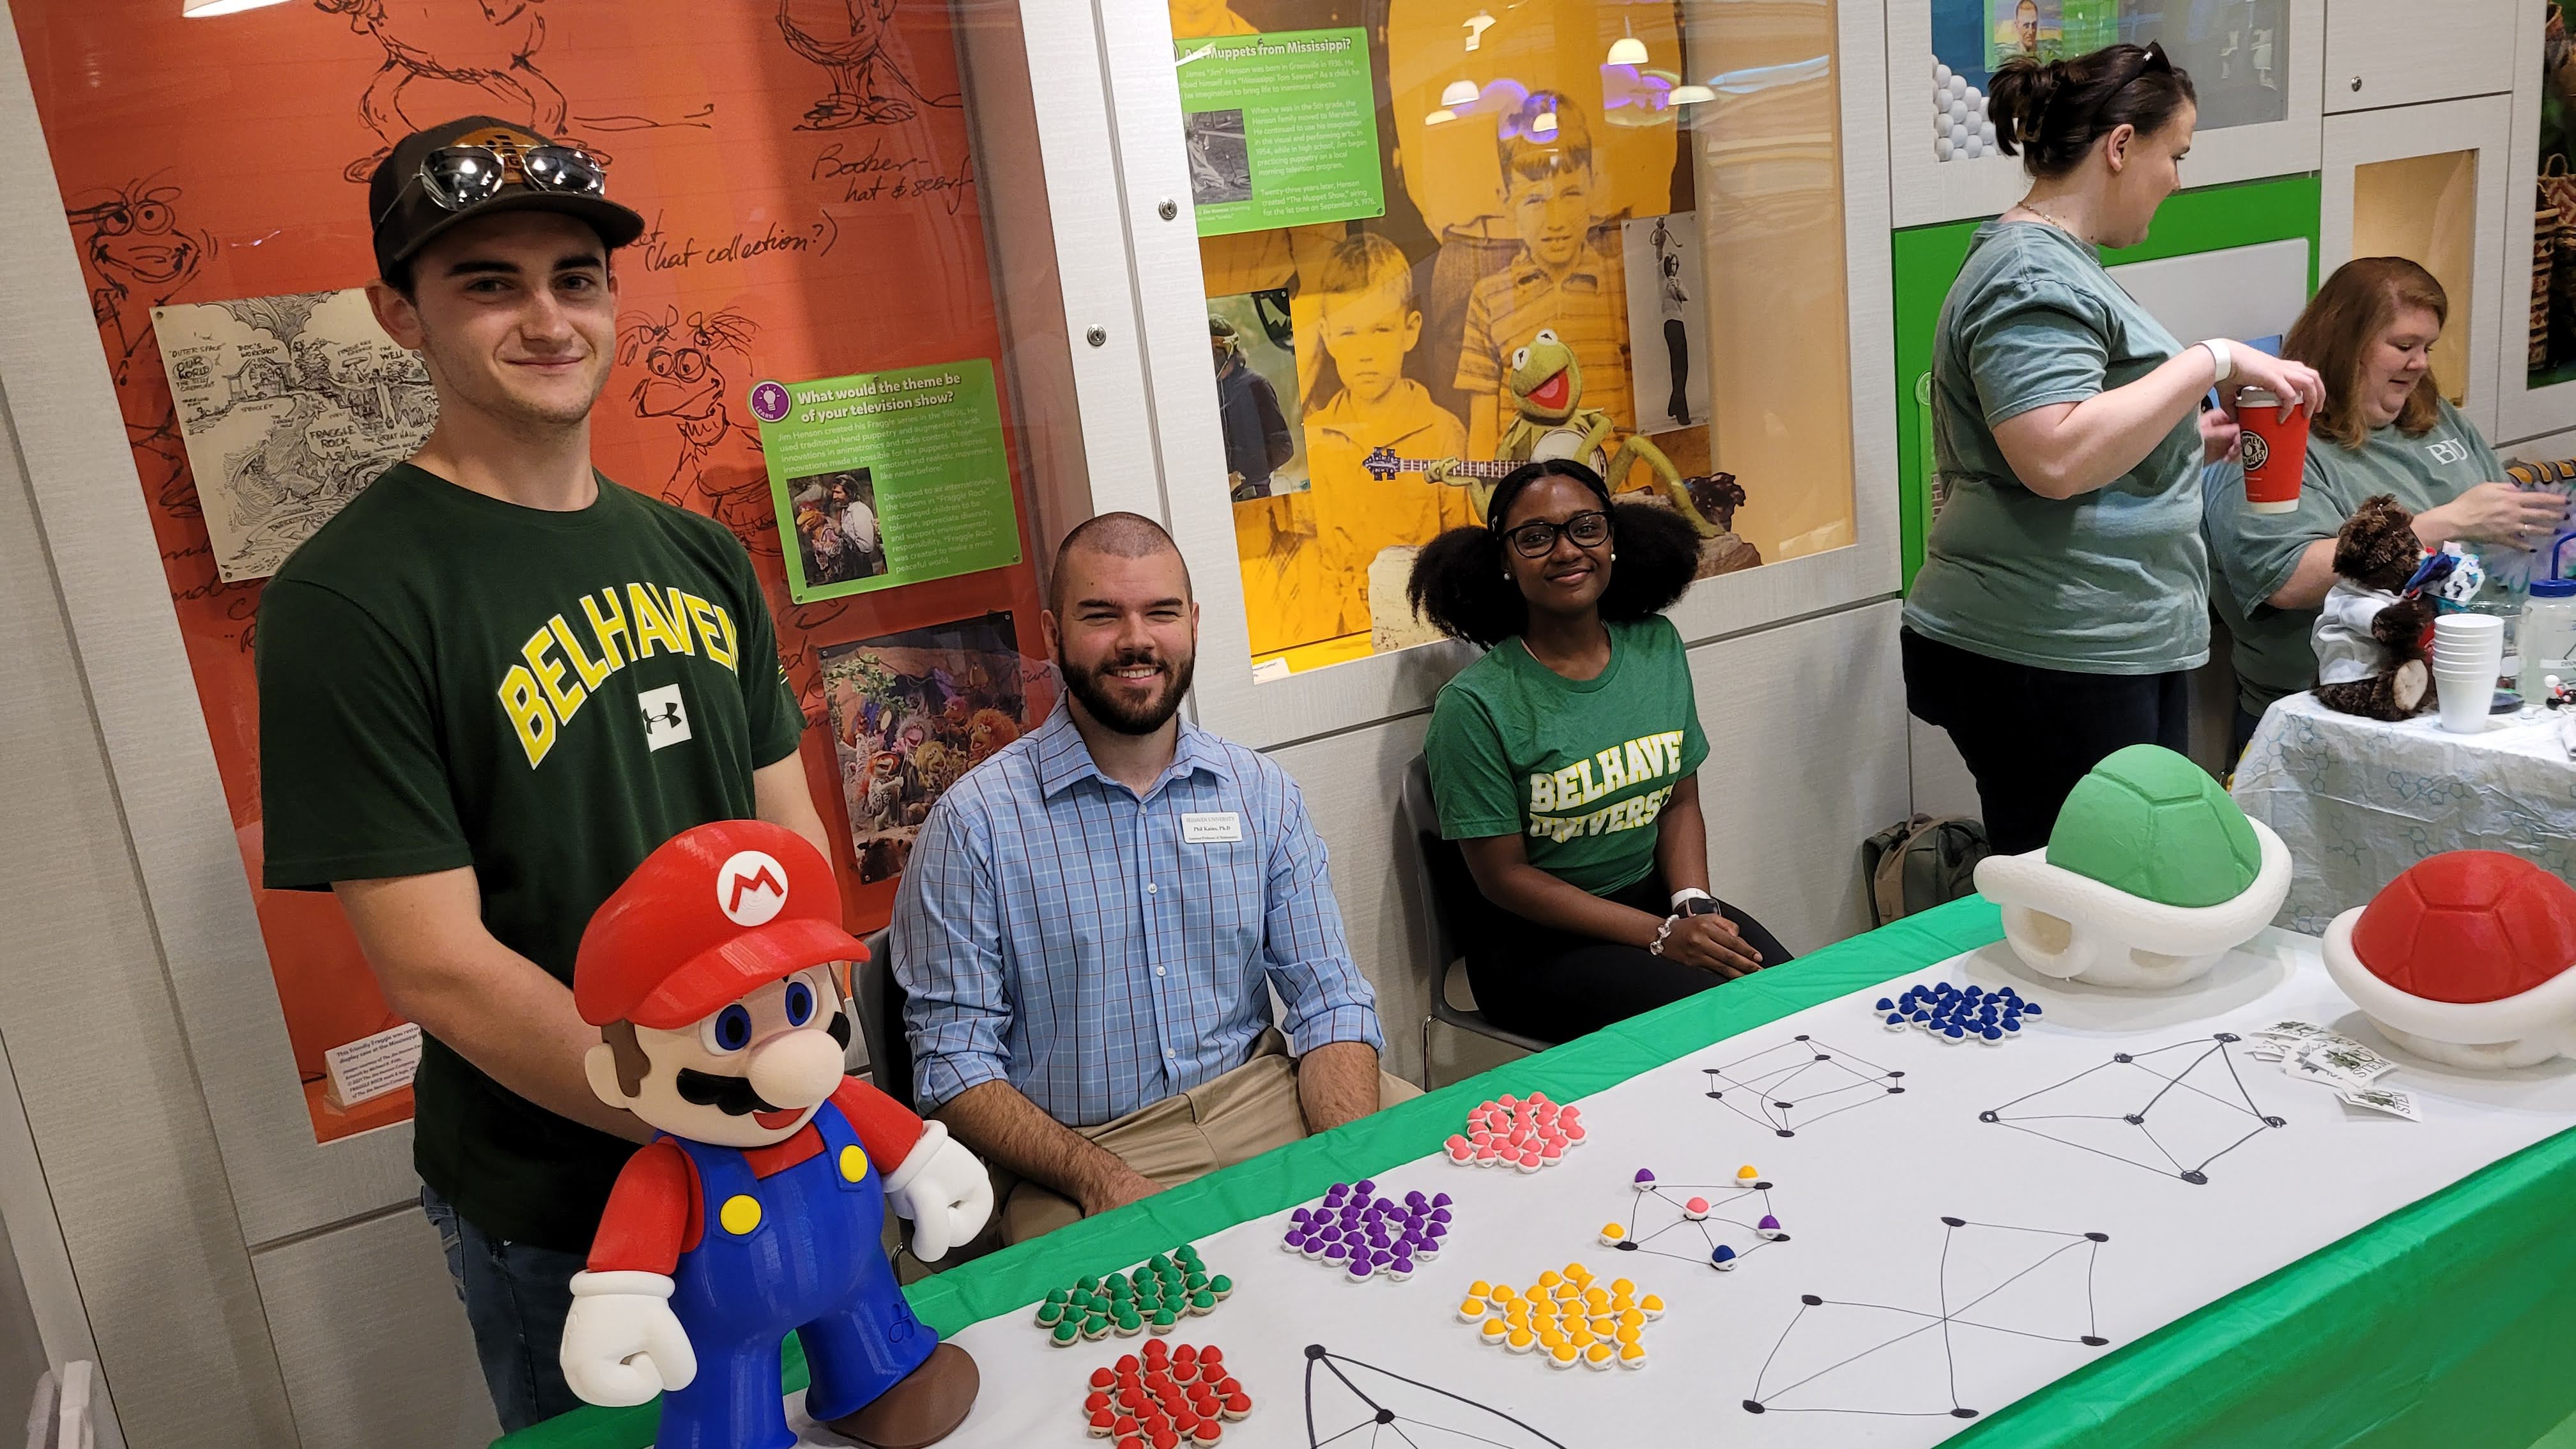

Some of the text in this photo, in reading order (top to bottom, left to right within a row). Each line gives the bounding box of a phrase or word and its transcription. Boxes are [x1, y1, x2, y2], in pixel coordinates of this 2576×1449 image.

[1207, 43, 1257, 62] Muppets
[1257, 42, 1285, 55] from
[1285, 37, 1352, 56] Mississippi?
[1195, 89, 1234, 100] imagination
[1242, 86, 1260, 96] bring
[1280, 82, 1310, 91] inanimate
[1312, 80, 1338, 91] objects.
[1252, 116, 1276, 125] Henson
[1276, 114, 1297, 124] family
[1297, 112, 1319, 121] moved
[1328, 109, 1359, 119] Maryland.
[1256, 155, 1289, 167] practicing
[1288, 153, 1319, 164] puppetry
[1333, 150, 1348, 158] local
[1257, 162, 1344, 177] morning television program.
[843, 176, 889, 204] hat
[1261, 185, 1302, 197] Twenty-three
[1319, 182, 1335, 192] later,
[1336, 180, 1360, 188] Henson
[1261, 197, 1285, 206] created
[1302, 193, 1327, 203] Muppet
[1349, 188, 1368, 198] airing
[1295, 204, 1310, 213] time
[1319, 200, 1353, 211] September
[1361, 197, 1376, 206] 1976.
[705, 210, 838, 265] collection?)
[796, 371, 961, 405] What would the theme be
[799, 389, 955, 424] of your television show?
[309, 425, 357, 439] FRAGGLE
[776, 432, 792, 441] Jim
[792, 427, 823, 440] Henson
[824, 423, 854, 435] created
[854, 421, 866, 431] his
[866, 417, 896, 431] Fraggle
[896, 414, 918, 424] series
[927, 411, 940, 420] the
[779, 441, 799, 452] used
[799, 436, 839, 449] traditional
[840, 433, 861, 443] hand
[861, 427, 897, 441] puppetry
[898, 425, 912, 435] and
[914, 420, 955, 434] augmented
[320, 437, 351, 448] ROCK
[781, 449, 827, 463] innovations
[836, 440, 885, 455] animatronics
[885, 438, 900, 448] and
[900, 435, 921, 445] radio
[921, 431, 950, 443] control.
[2424, 437, 2468, 466] BU
[783, 459, 829, 473] innovations
[829, 456, 851, 466] made
[859, 450, 891, 464] possible
[891, 448, 903, 457] for
[904, 446, 917, 456] the
[917, 441, 949, 455] puppets
[877, 458, 909, 470] emotion
[909, 456, 924, 465] and
[925, 451, 954, 463] realistic
[879, 463, 942, 480] like never before!
[886, 507, 930, 523] encouraged
[931, 502, 960, 514] children
[890, 519, 988, 542] and support environmental
[895, 556, 951, 574] peaceful world.
[1529, 730, 1684, 813] BELHAVE
[729, 864, 785, 914] M
[2352, 1059, 2391, 1078] STEM
